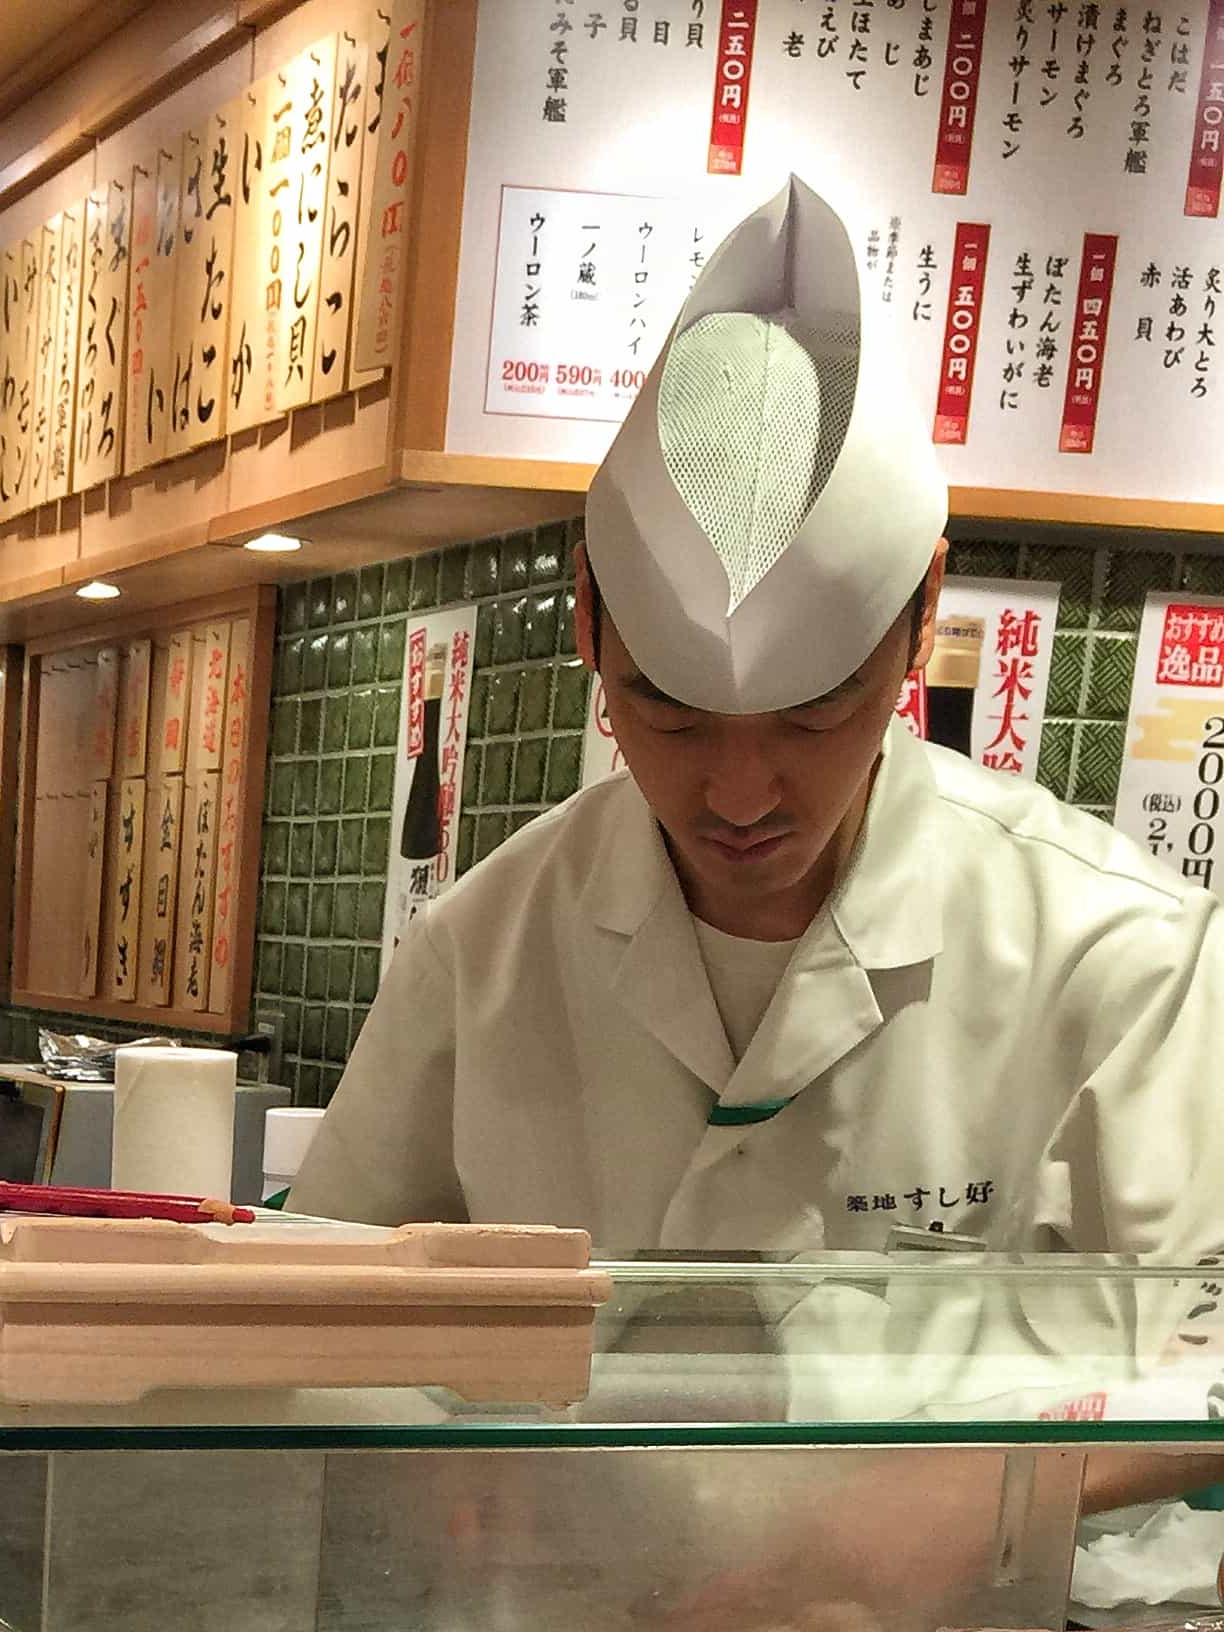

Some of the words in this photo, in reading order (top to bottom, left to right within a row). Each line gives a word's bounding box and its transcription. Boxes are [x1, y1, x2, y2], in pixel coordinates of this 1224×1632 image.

[543, 0, 575, 122] みそ軍艦
[817, 0, 839, 59] えび
[1040, 3, 1068, 107] サーモン
[1067, 3, 1101, 139] 漬けまぐろ
[1105, 8, 1128, 86] まぐろ
[1167, 17, 1192, 94] こはだ
[1124, 10, 1162, 174] ねぎとろ軍艦
[520, 212, 546, 327] ウーロン茶
[628, 221, 654, 356] ウーロンハイ
[912, 244, 938, 322] 生うに
[1032, 255, 1070, 389] ぼたん海老
[1163, 265, 1194, 370] 活あわび
[1000, 252, 1035, 411] 生ずわいがに
[1190, 267, 1223, 398] 炙り大とろ
[1158, 644, 1223, 683] 逸品
[903, 1179, 995, 1211] すし好
